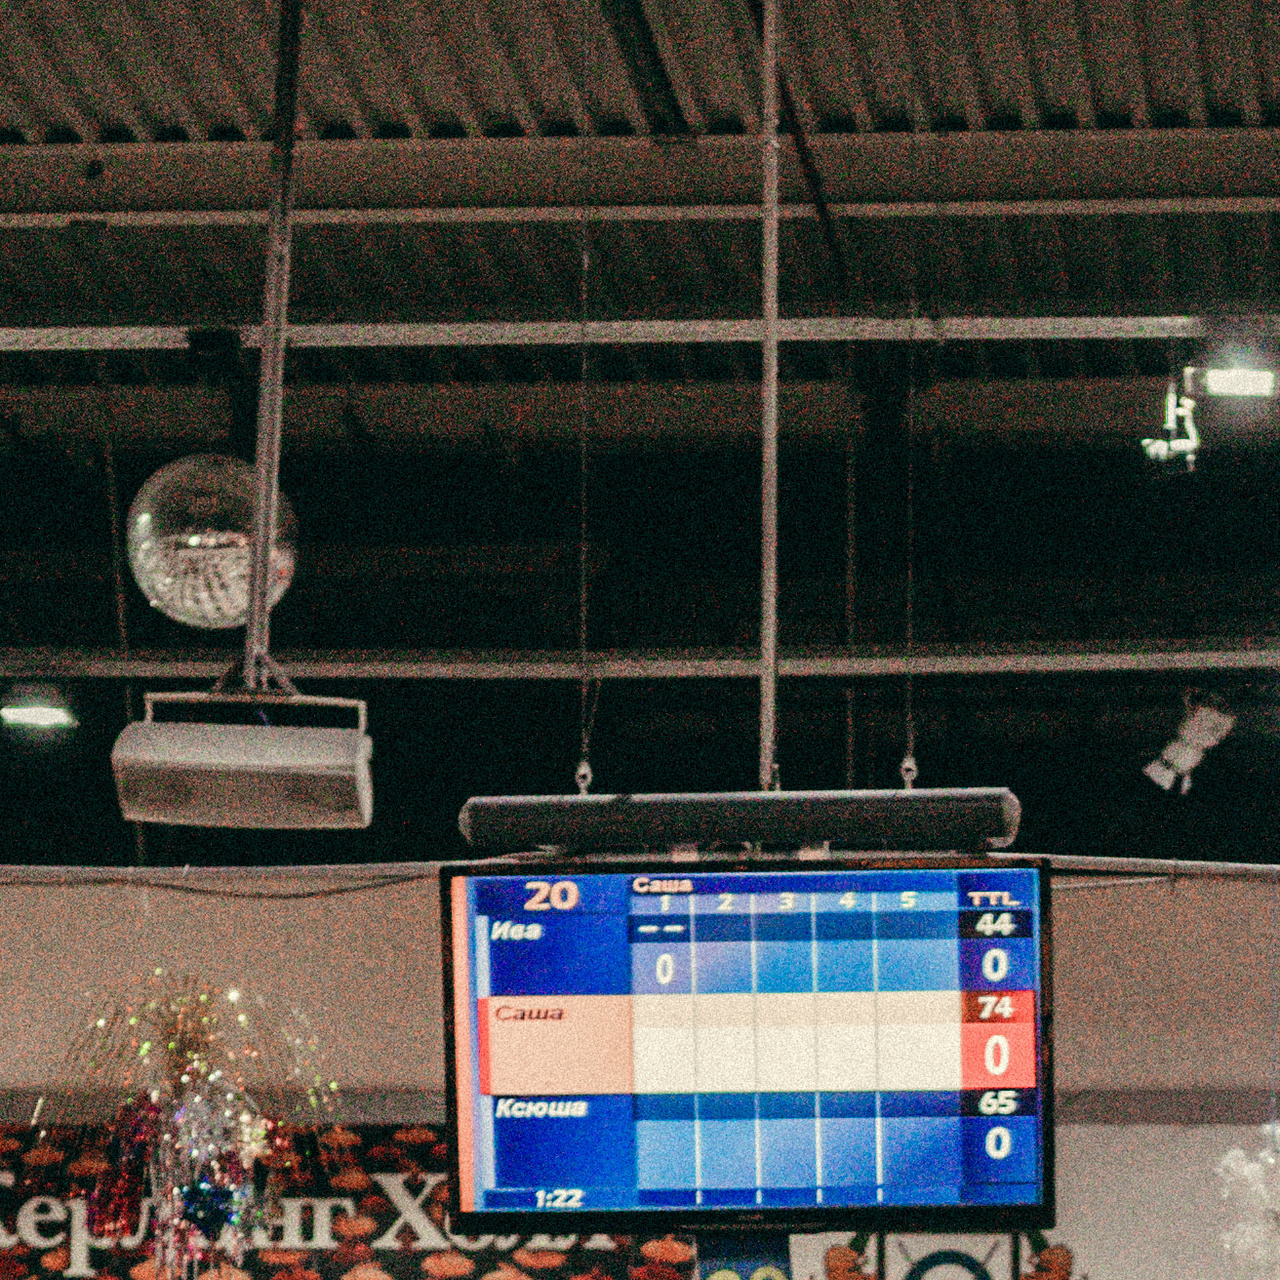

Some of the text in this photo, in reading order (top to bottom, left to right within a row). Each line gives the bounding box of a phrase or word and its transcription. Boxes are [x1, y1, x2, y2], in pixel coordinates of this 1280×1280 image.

[523, 880, 580, 911] 20
[632, 876, 695, 893] Саша
[716, 894, 734, 912] 2
[779, 892, 796, 909] 3
[838, 891, 857, 909] 4
[899, 891, 919, 909] 5
[967, 891, 1020, 907] TTL
[491, 920, 544, 941] Ива
[975, 912, 1018, 937] 44
[655, 948, 1010, 985] 0 0
[494, 995, 1016, 1022] Саша 74
[984, 1034, 1010, 1076] 0
[495, 1090, 1019, 1118] Ксюша 65
[985, 1126, 1012, 1160] 0
[535, 1188, 585, 1208] 1:22
